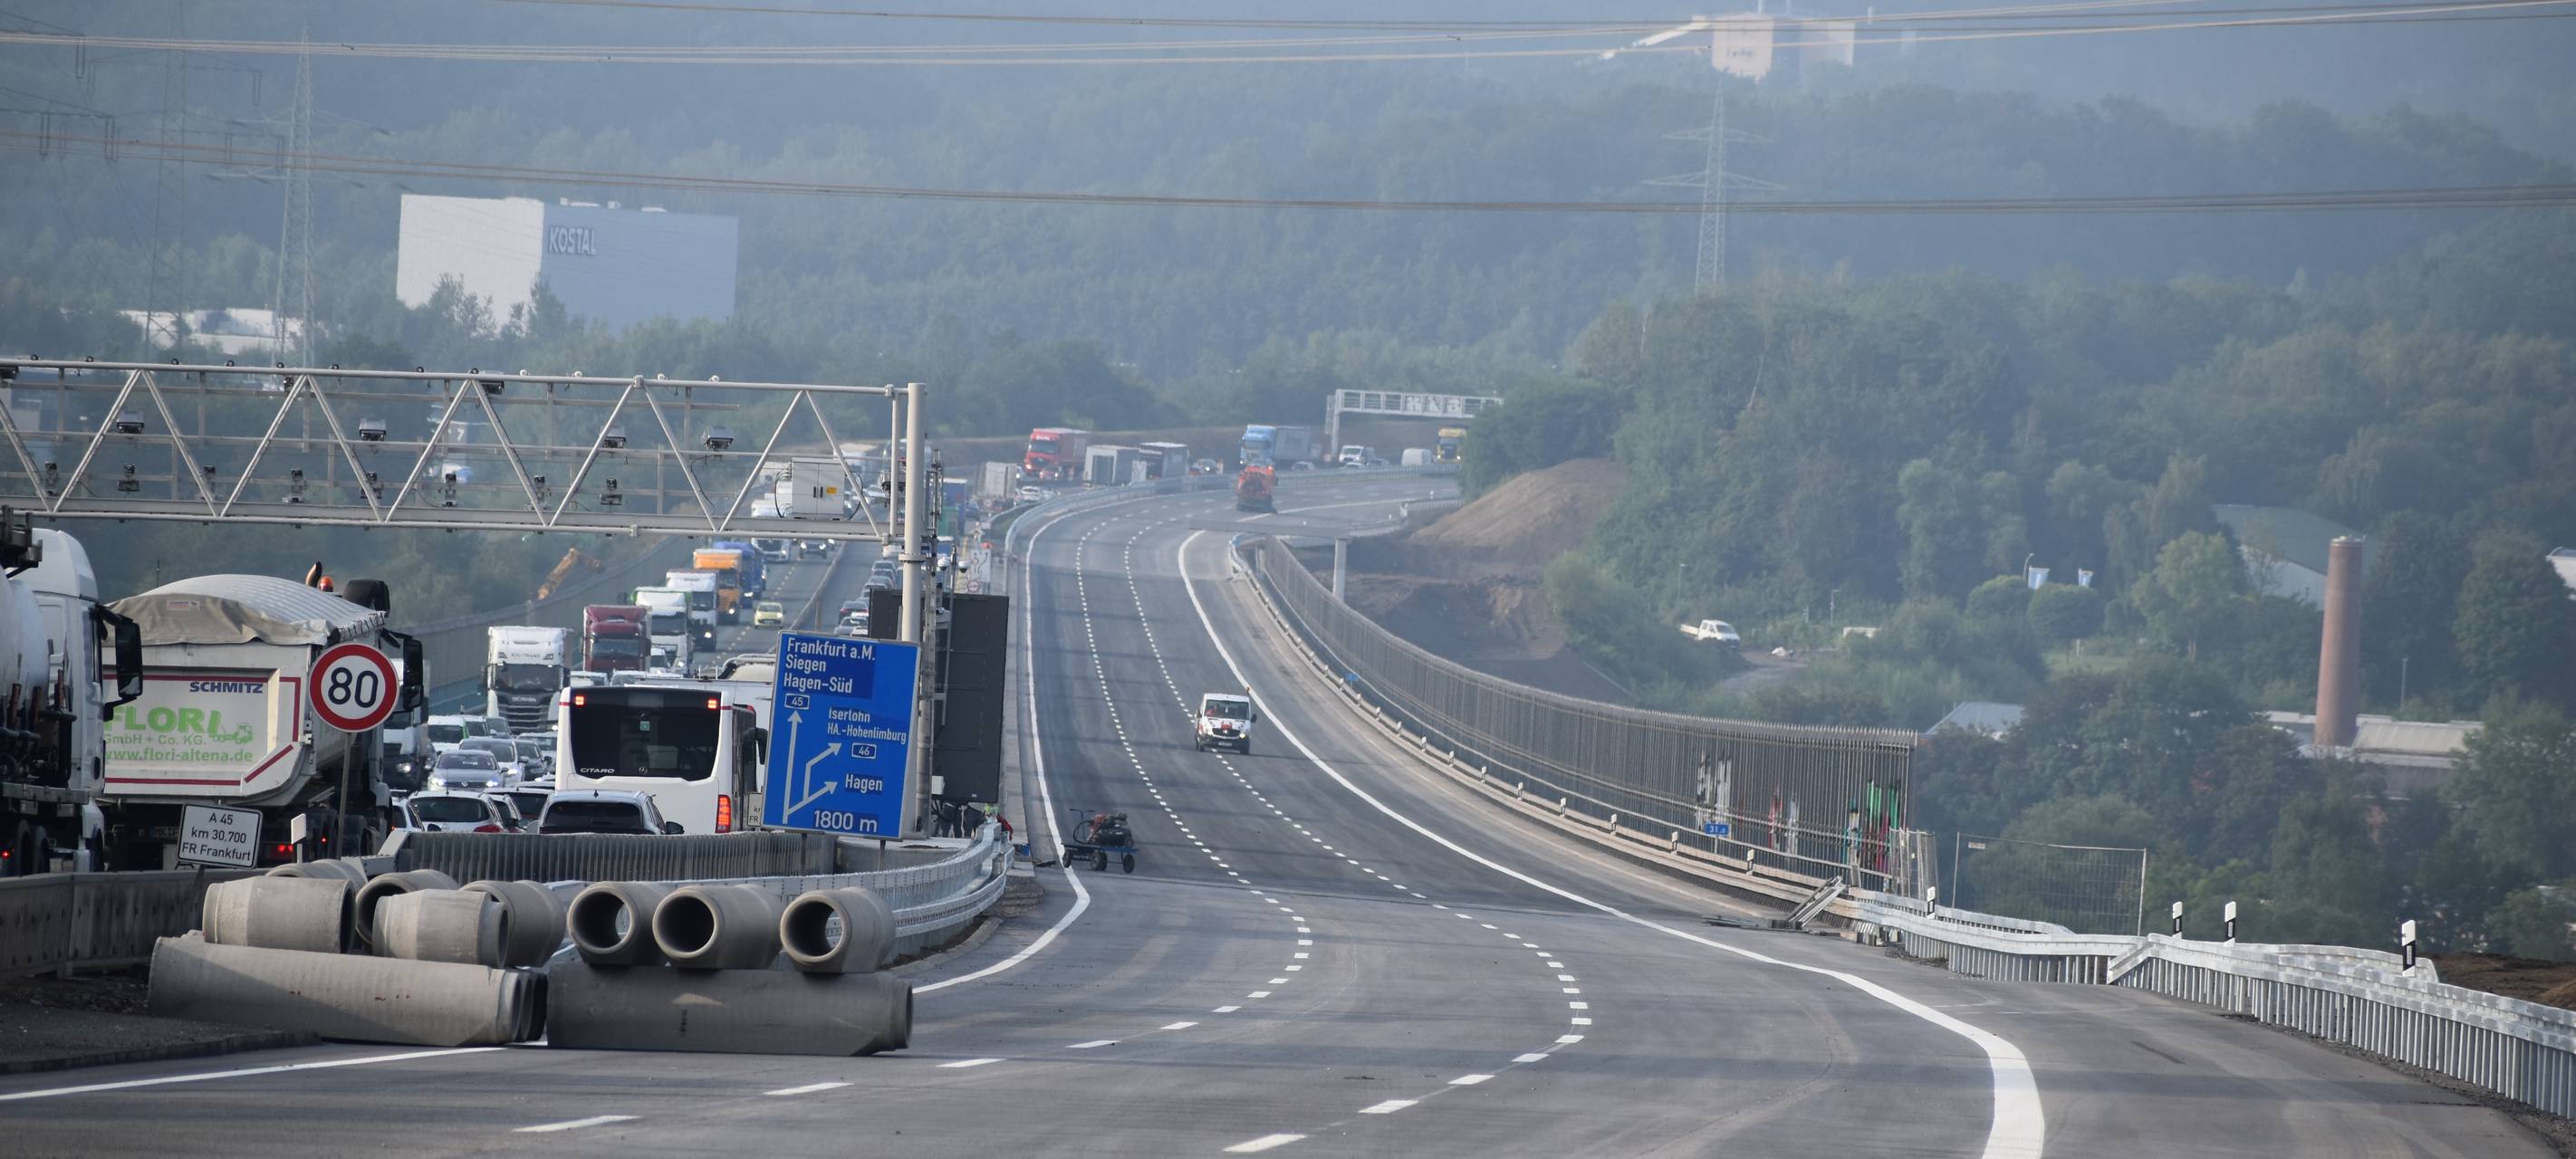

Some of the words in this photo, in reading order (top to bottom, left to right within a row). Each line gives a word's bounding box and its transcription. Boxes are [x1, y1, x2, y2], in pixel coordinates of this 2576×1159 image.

[549, 226, 597, 255] KOSTAL
[787, 637, 846, 657] Frankfurt
[850, 645, 876, 661] a.M.
[785, 654, 827, 674] Siegen
[189, 681, 264, 694] SCHMITZ
[328, 666, 379, 708] 80
[783, 672, 852, 694] Hagen-Süd
[791, 695, 804, 706] 45
[829, 707, 870, 723] Iserlohn
[105, 733, 142, 745] GmbH
[158, 734, 178, 745] Co.
[183, 734, 207, 745] KG.
[827, 722, 907, 745] HA.-Hohenlimburg
[105, 747, 254, 761] www.flori-altena.de
[858, 746, 870, 756] 46
[845, 773, 883, 793] Hagen
[208, 812, 216, 823] A
[220, 813, 234, 825] 45
[813, 810, 853, 830] 1800
[860, 818, 878, 833] m
[191, 827, 209, 838] km
[182, 842, 197, 854] FR
[199, 844, 251, 860] Frankfurt
